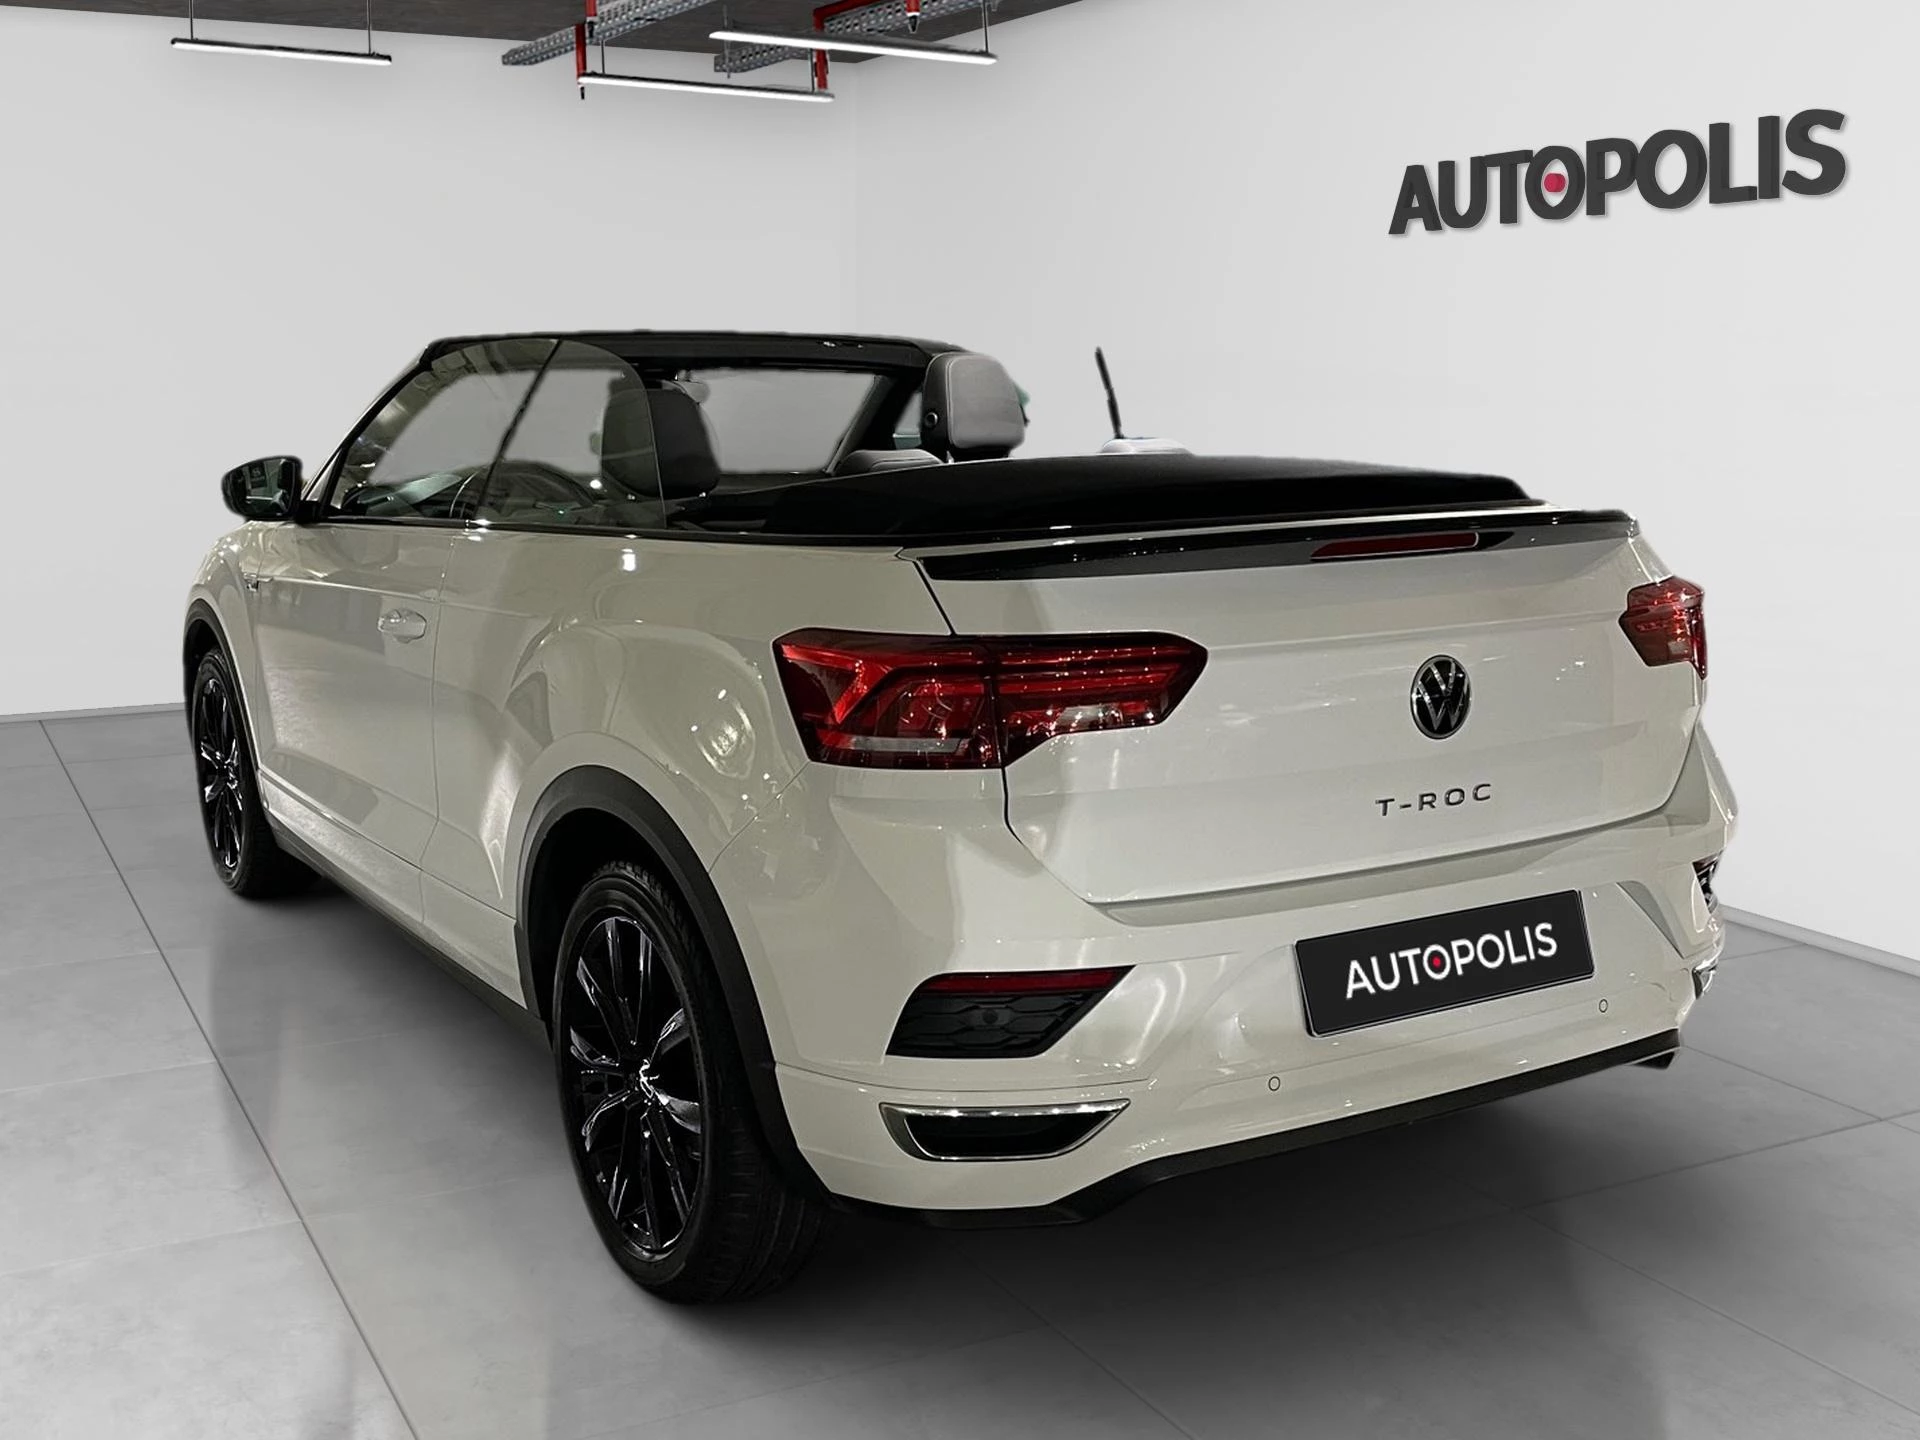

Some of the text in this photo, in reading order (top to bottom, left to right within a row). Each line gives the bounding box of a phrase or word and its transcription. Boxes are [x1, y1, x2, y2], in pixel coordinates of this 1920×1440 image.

[1388, 108, 1846, 235] AUTOPOLIS
[1375, 783, 1493, 816] T-ROC
[1345, 922, 1557, 1000] AUTOPOLIS
